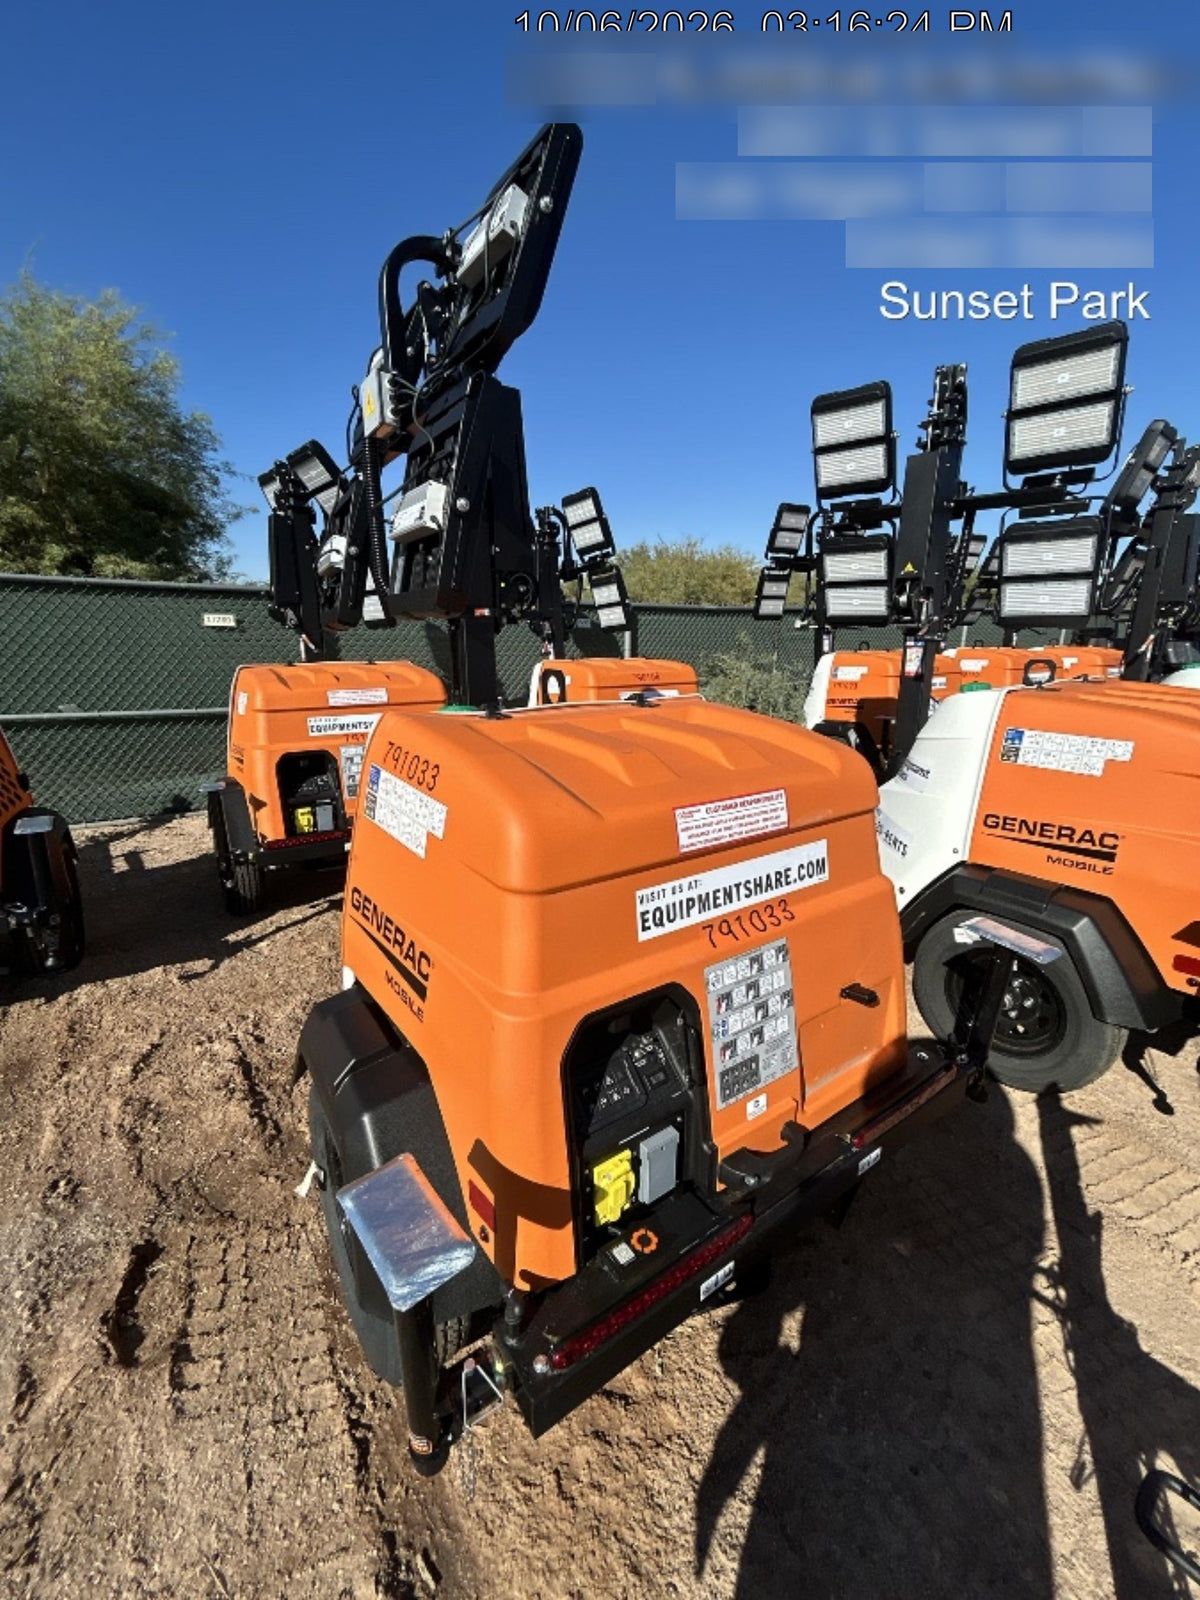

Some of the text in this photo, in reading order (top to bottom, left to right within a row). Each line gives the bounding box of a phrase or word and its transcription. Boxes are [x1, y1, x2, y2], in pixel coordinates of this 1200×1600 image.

[383, 741, 440, 791] 791033
[982, 813, 1120, 850] GENERAC
[1046, 855, 1115, 876] MOBILE
[638, 889, 667, 906] VISIT
[640, 857, 826, 932] EQUIPMENTSHARE.COM
[351, 886, 431, 982] GENERAC
[702, 899, 795, 948] 791033
[384, 970, 424, 1023] MOBILE
